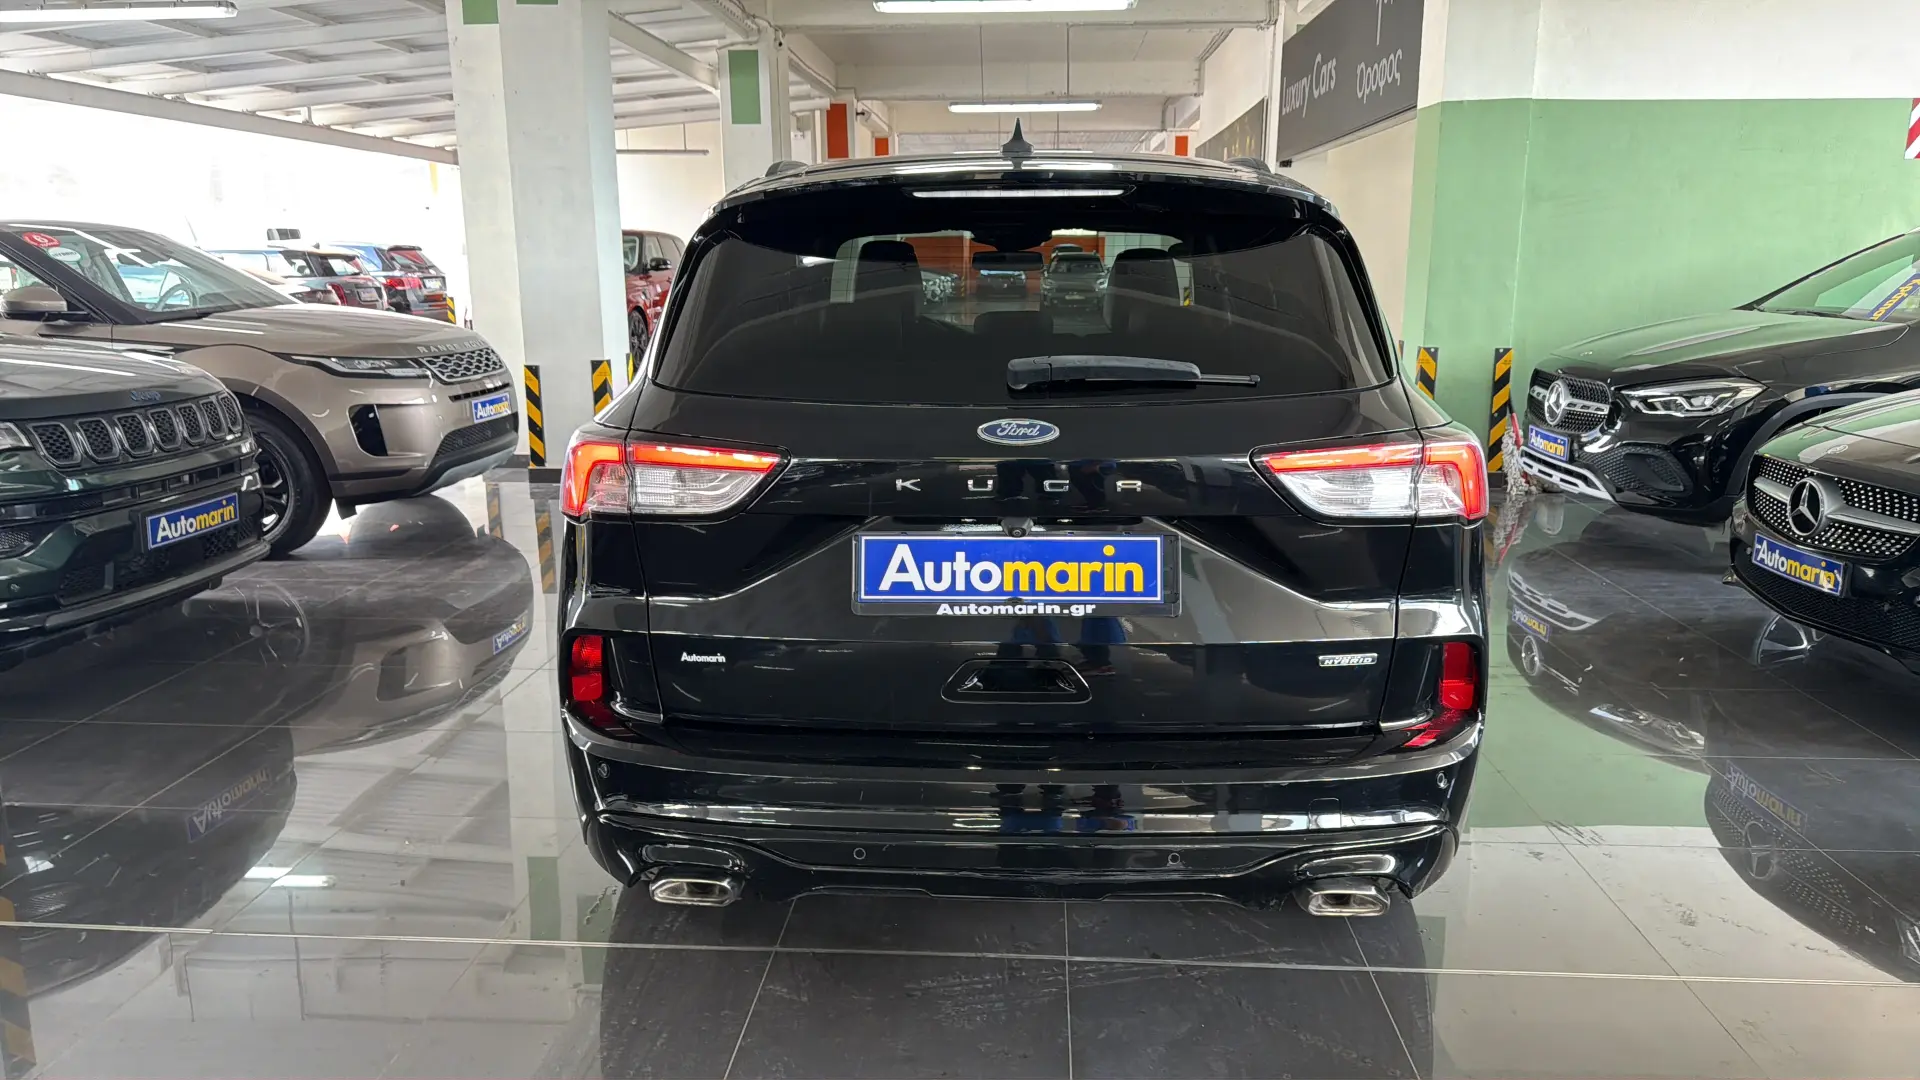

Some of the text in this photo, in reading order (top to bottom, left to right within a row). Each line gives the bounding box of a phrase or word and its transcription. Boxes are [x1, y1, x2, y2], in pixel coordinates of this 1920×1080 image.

[1281, 52, 1337, 118] Luxury Cars
[416, 343, 460, 354] RANGE
[996, 421, 1041, 437] Ford
[895, 478, 1143, 493] KUGA
[156, 499, 236, 543] Automarin
[877, 543, 1145, 593] Automarin
[1756, 539, 1836, 590] Automarin
[936, 603, 1097, 617] Automarin.gr
[680, 651, 727, 663] Automarin
[1323, 656, 1374, 666] HYBRID
